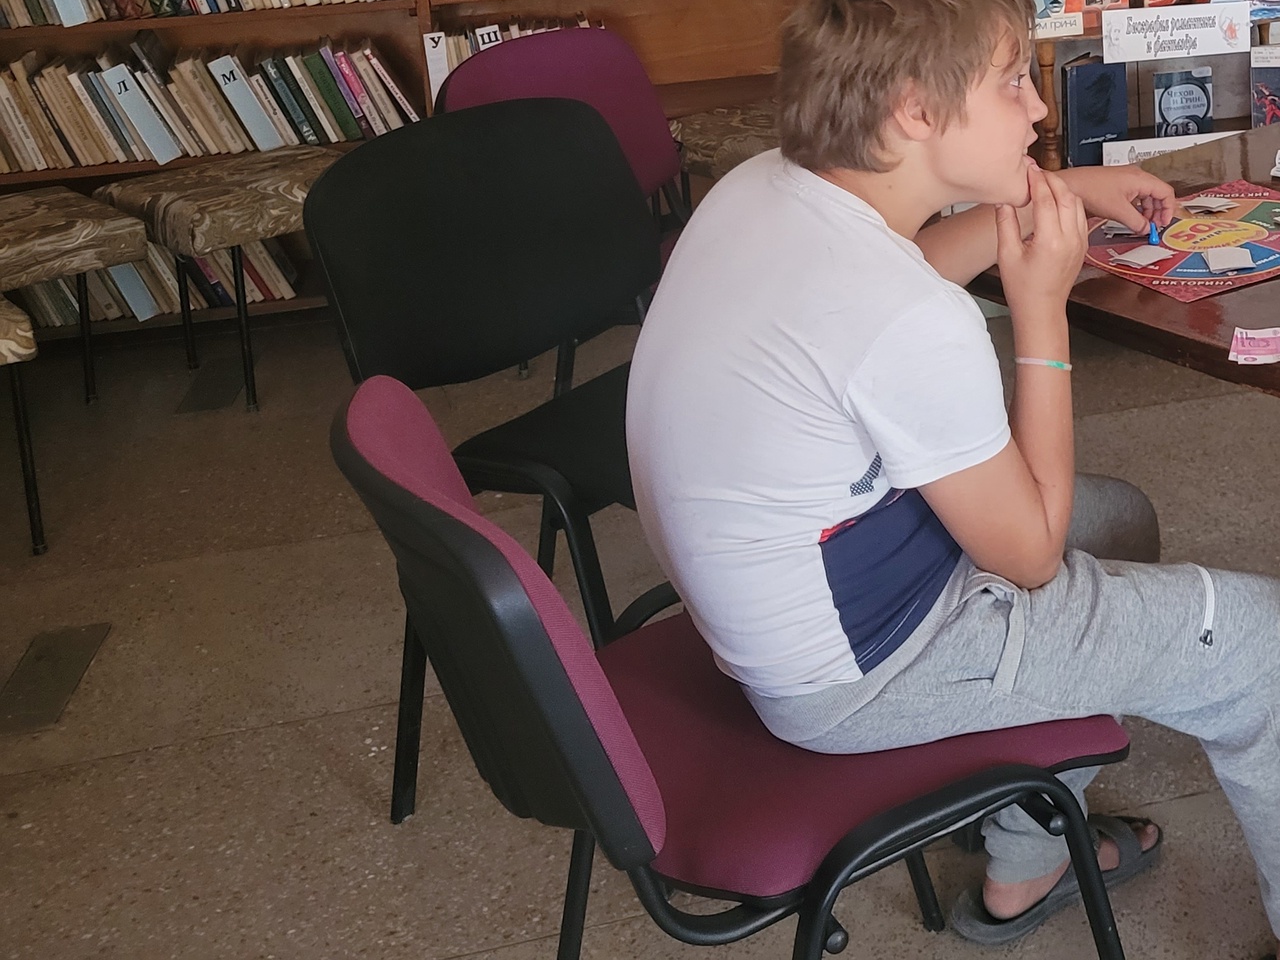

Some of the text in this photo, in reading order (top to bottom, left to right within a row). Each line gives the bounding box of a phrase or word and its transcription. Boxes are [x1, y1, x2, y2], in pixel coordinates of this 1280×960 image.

[429, 35, 443, 49] У
[478, 30, 500, 46] Ш
[220, 69, 238, 85] М
[116, 79, 131, 95] Л
[1170, 222, 1238, 242] 500
[1151, 279, 1234, 287] ВИКТОРИНА
